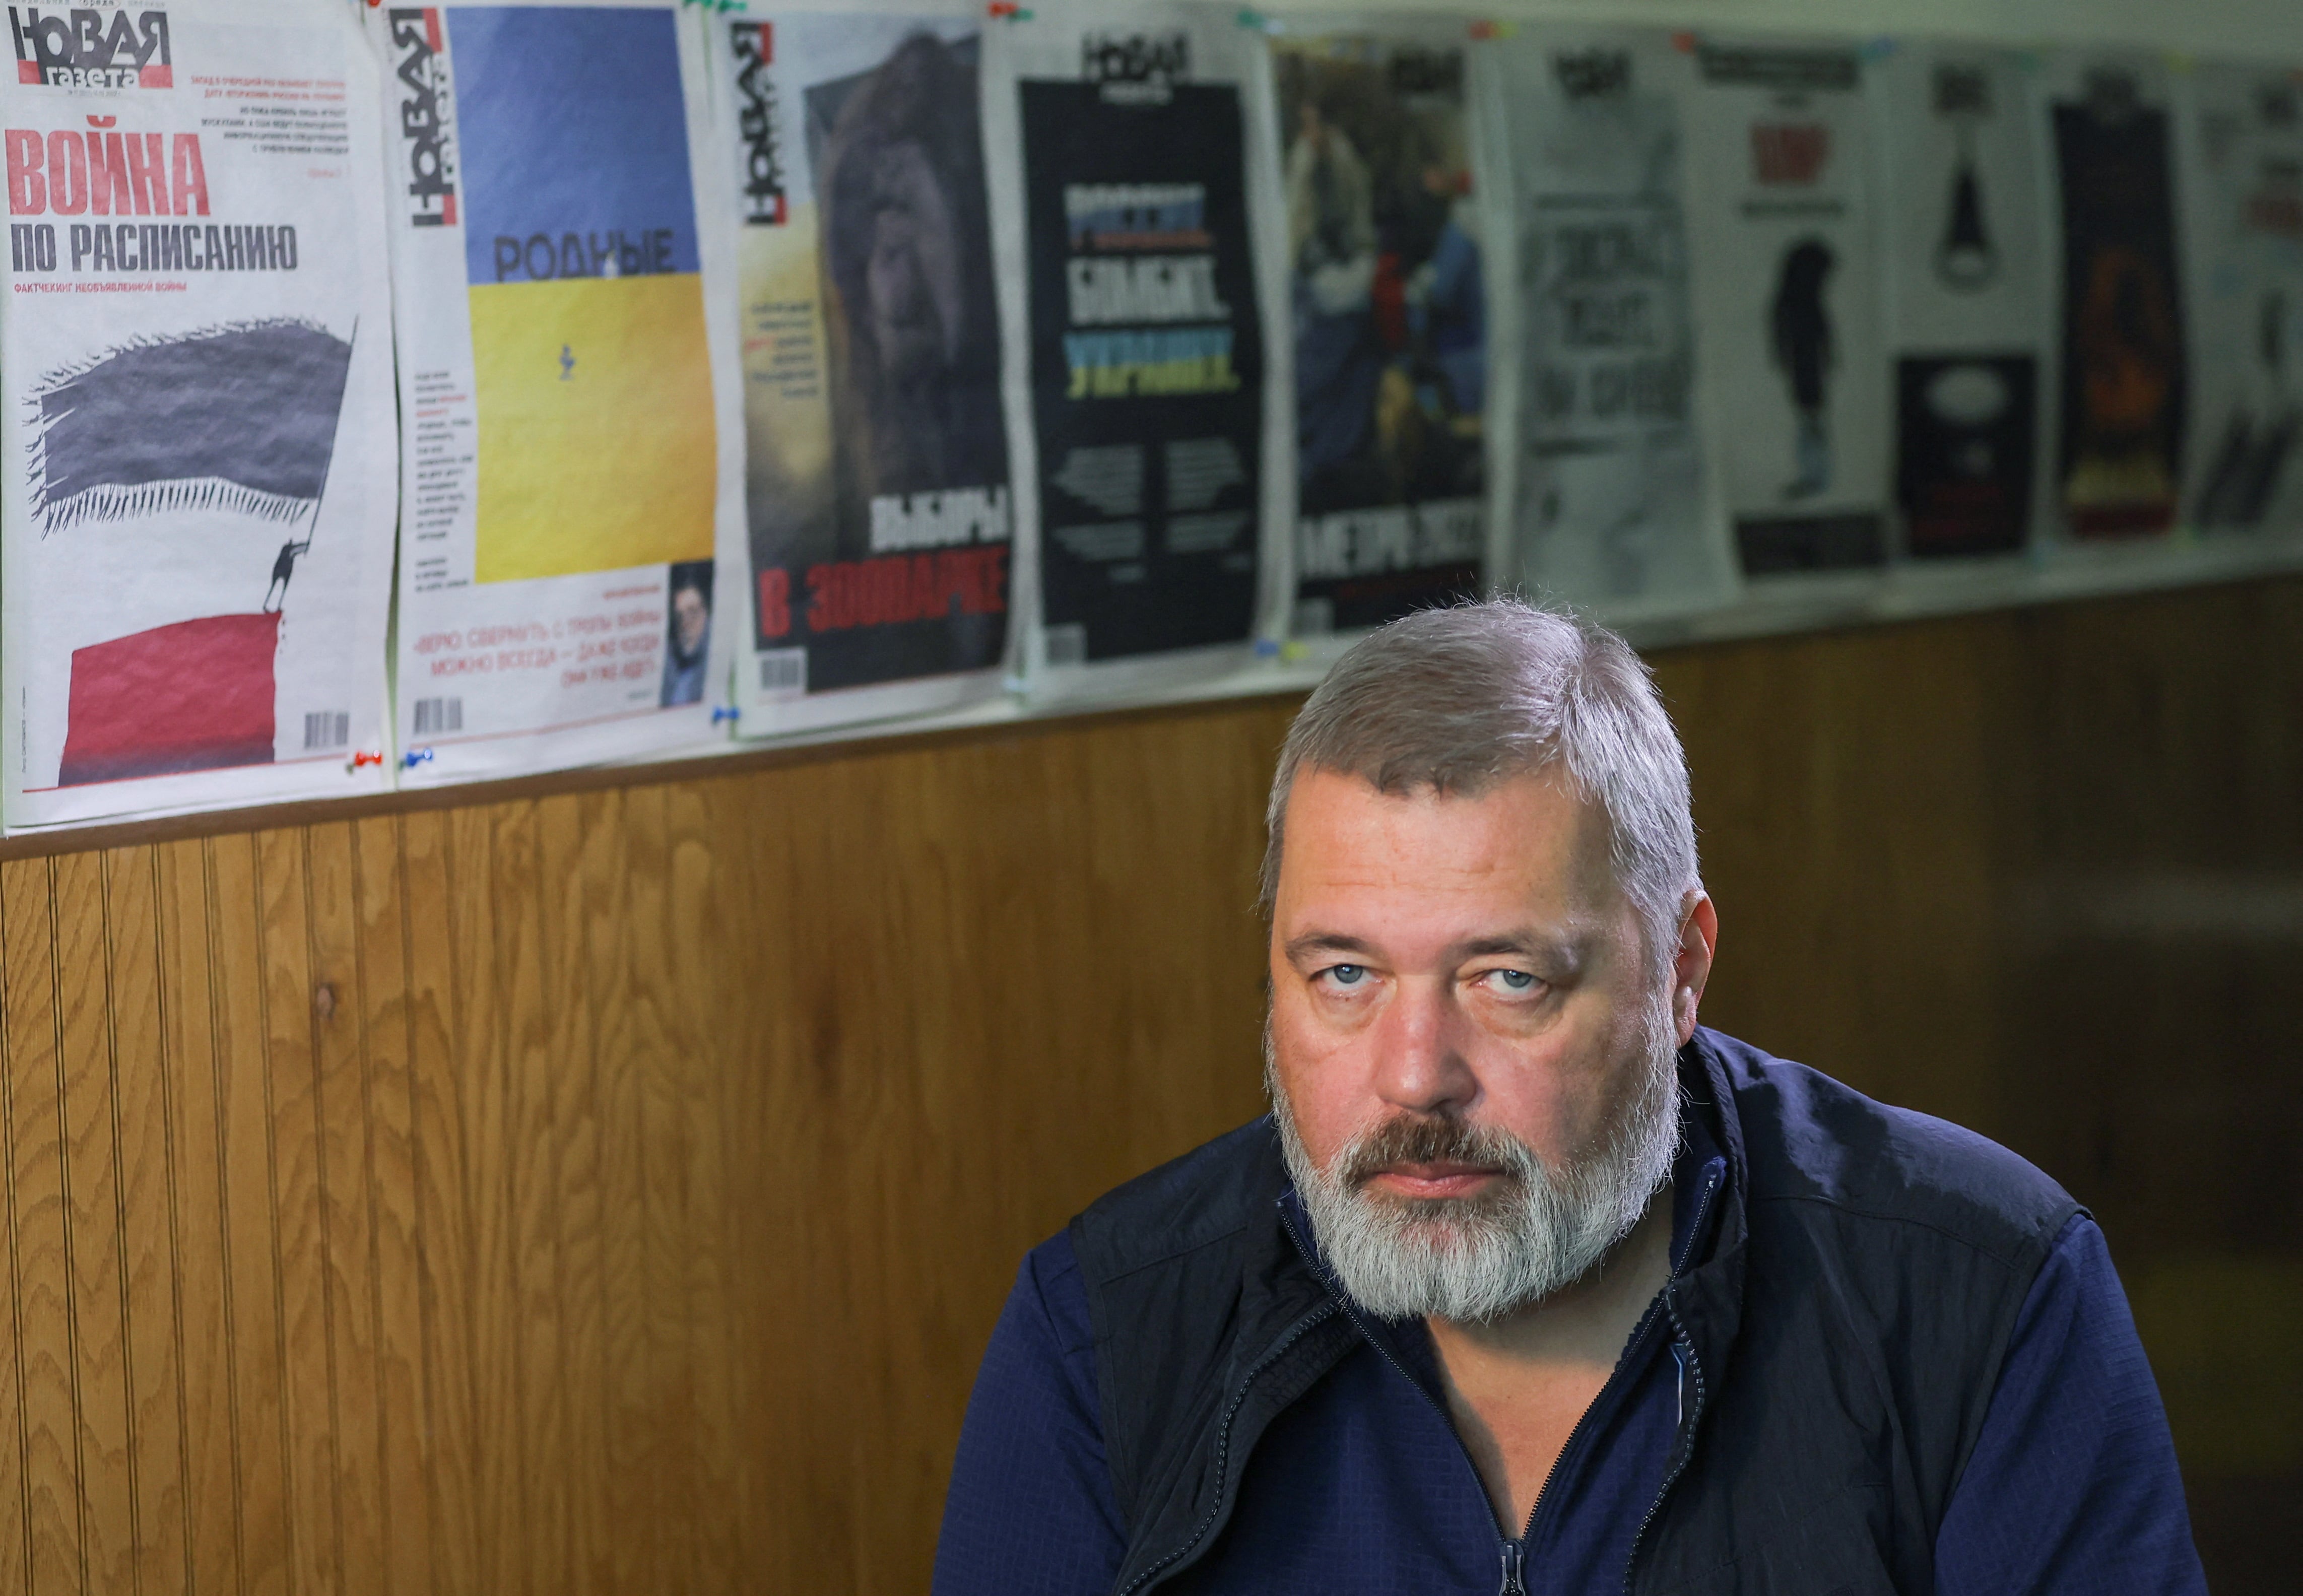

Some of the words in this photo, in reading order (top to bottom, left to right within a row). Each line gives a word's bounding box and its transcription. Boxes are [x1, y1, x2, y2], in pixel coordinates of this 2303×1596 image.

[8, 6, 173, 89] НОВАЯ
[46, 66, 139, 89] газета
[389, 8, 457, 226] НОВАЯ
[5, 115, 211, 216] ВОЙНА
[11, 224, 56, 272] ПО
[70, 224, 298, 272] РАСПИСАНИЮ
[493, 228, 676, 283] РОДНЫЕ
[14, 283, 72, 293] ФАКТЧЕКИНГ
[76, 279, 153, 293] НЕОБЪЯВЛЕННОЙ
[155, 280, 187, 292] ВОЙНЫ
[869, 485, 1008, 553] ВЫБОРЫ
[760, 568, 791, 638] В
[807, 545, 1008, 632] ЗООПАРКЕ
